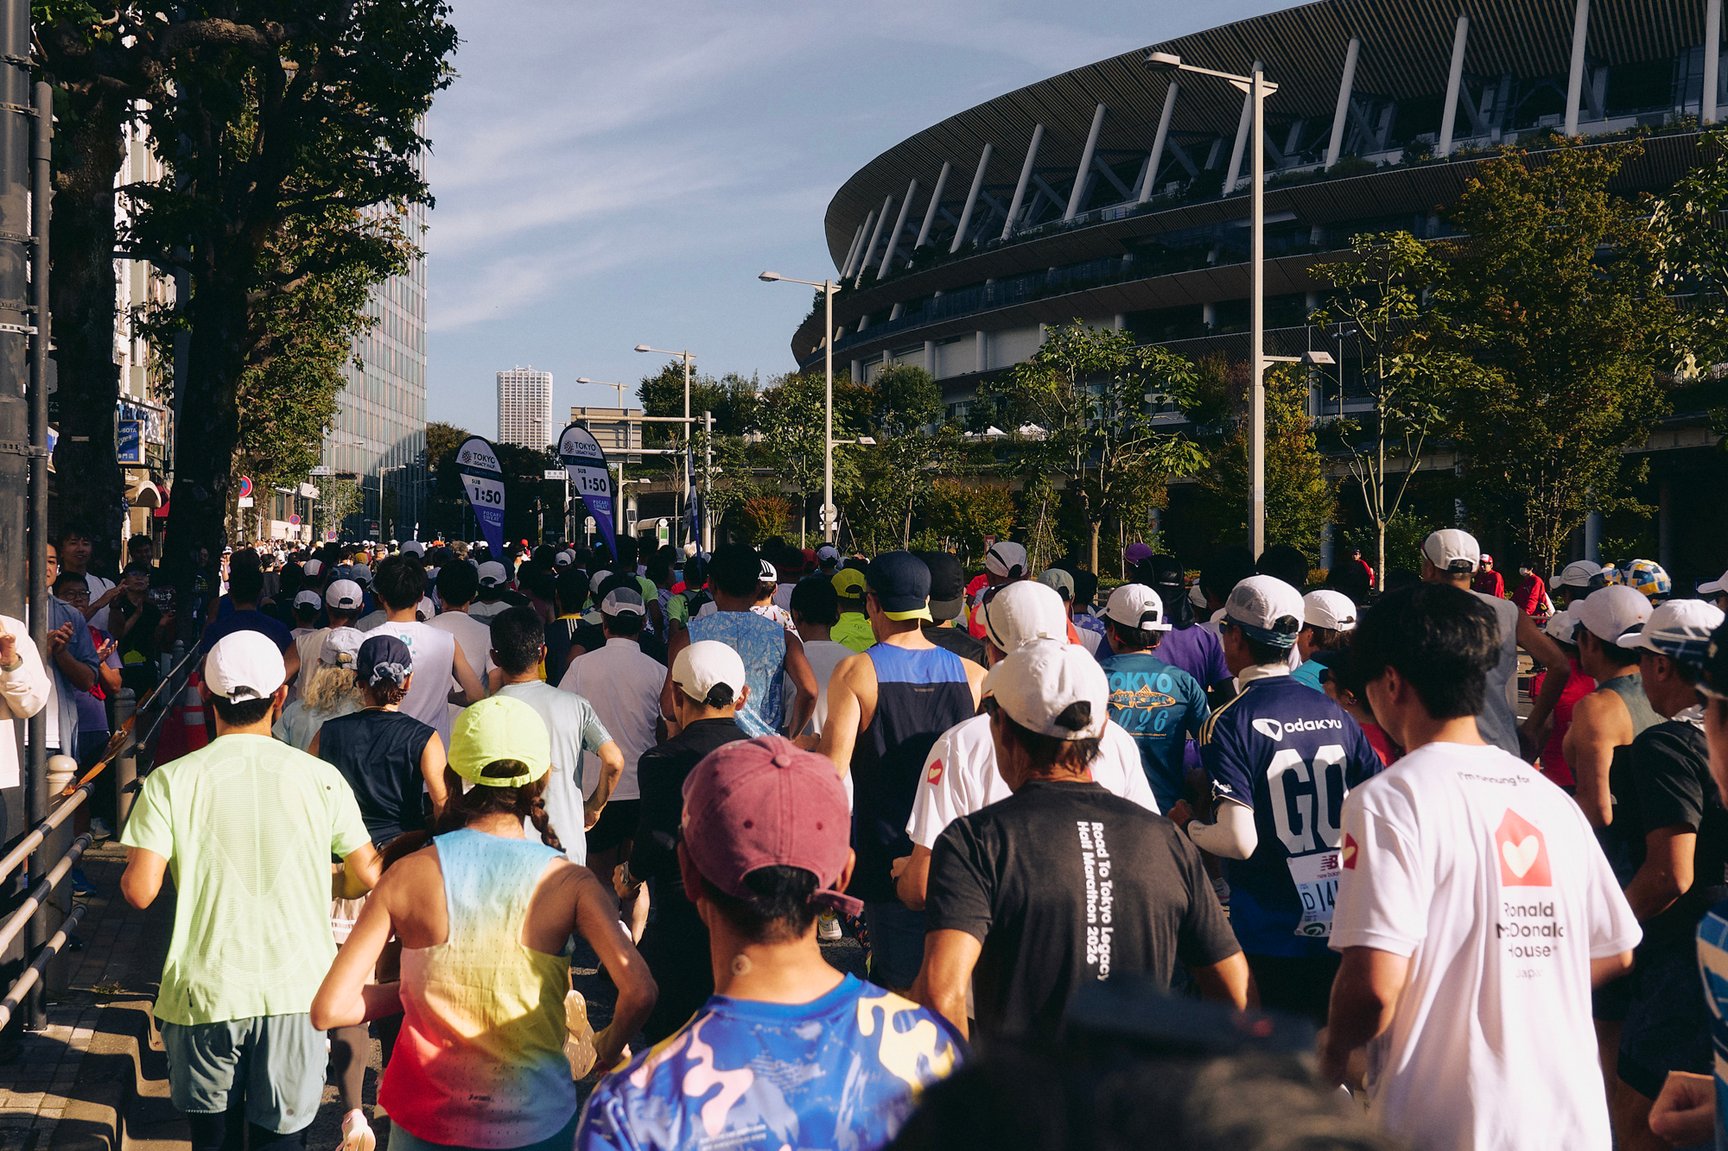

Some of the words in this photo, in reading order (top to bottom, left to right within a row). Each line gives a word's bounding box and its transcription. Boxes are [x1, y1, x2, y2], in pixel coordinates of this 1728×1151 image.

[574, 442, 597, 452] TOKYO
[473, 452, 496, 464] TOKYO
[581, 477, 607, 492] 1:50
[474, 487, 501, 504] 1:50
[1107, 671, 1173, 694] OKYO
[1284, 718, 1342, 733] odakyu
[1076, 821, 1094, 849] Half
[1091, 821, 1110, 858] Road
[1098, 860, 1111, 878] To
[1082, 851, 1099, 923] Marathon
[1099, 879, 1114, 924] Tokyo
[1504, 901, 1555, 917] Ronald
[1086, 926, 1099, 965] 2026
[1097, 927, 1114, 981] Legacy
